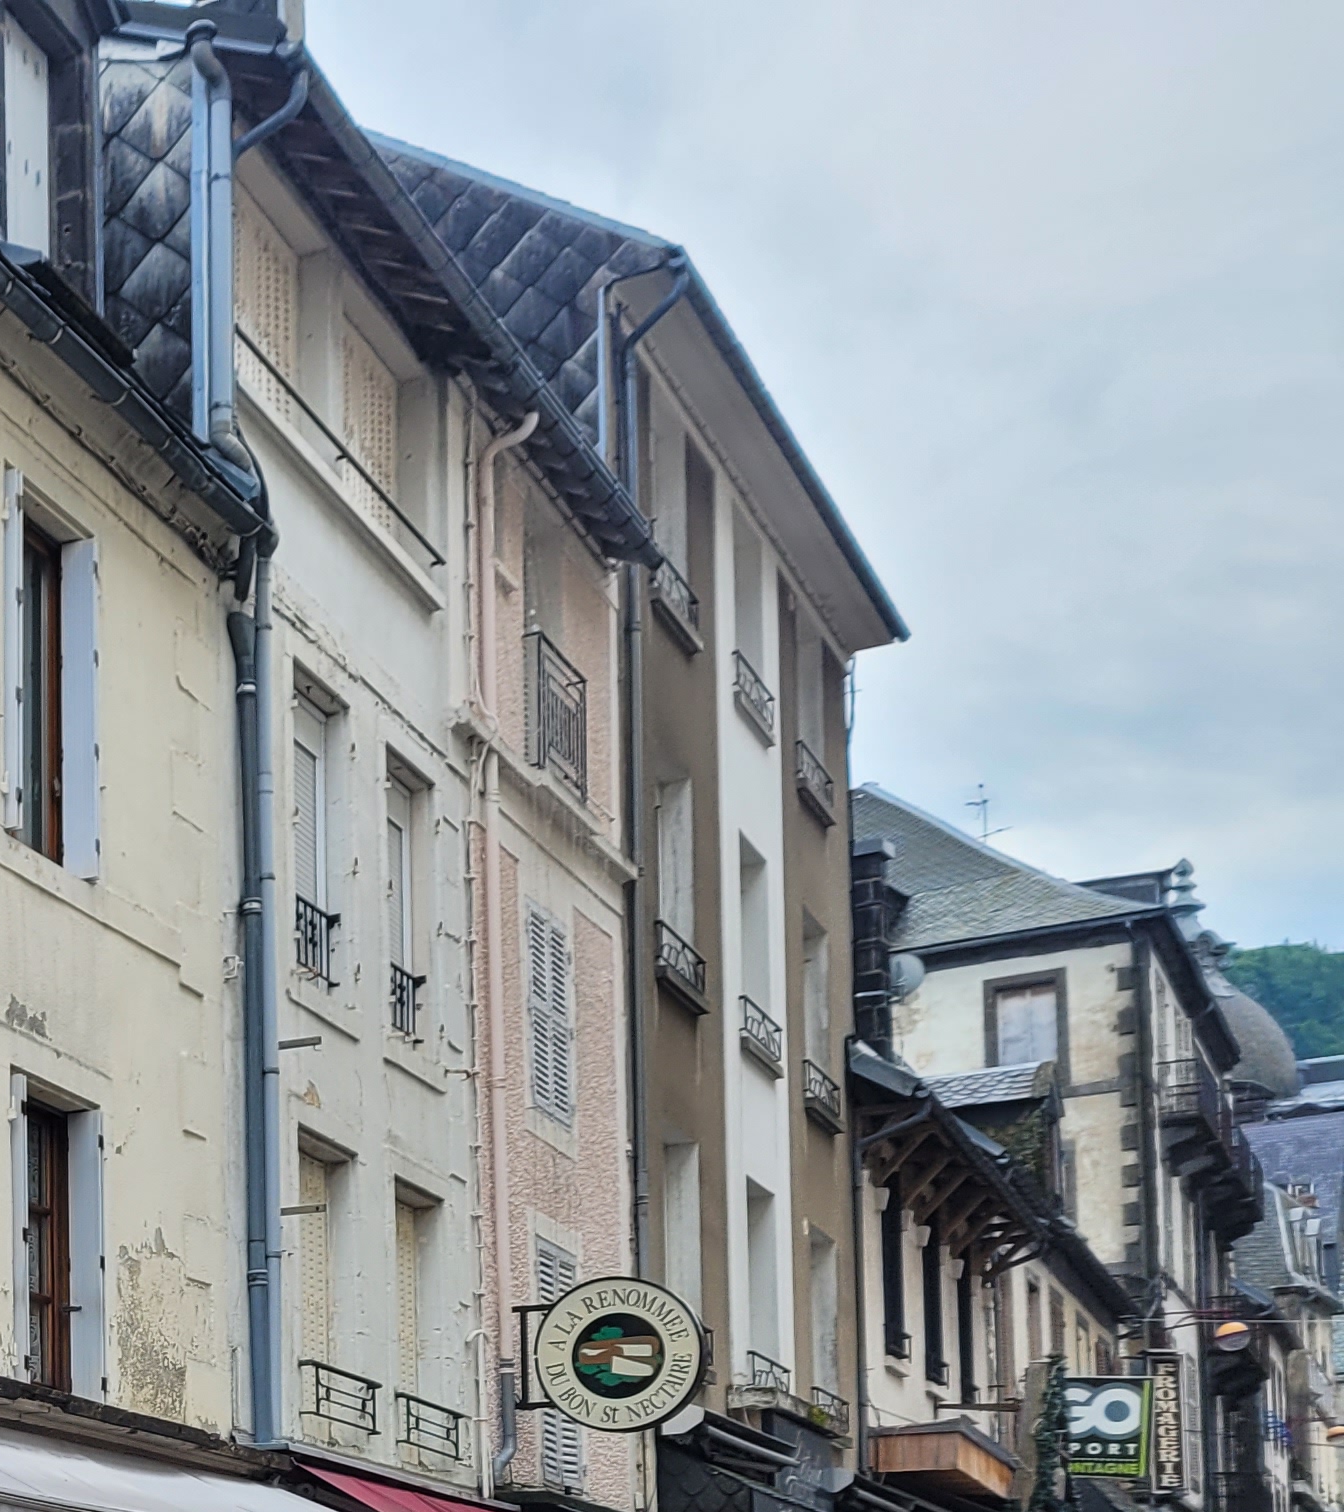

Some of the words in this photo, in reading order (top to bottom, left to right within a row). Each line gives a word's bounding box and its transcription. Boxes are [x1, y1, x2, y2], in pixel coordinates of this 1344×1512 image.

[554, 1311, 584, 1336] LA
[580, 1288, 690, 1343] RENOMMEE
[547, 1339, 567, 1352] A
[546, 1363, 570, 1387] DU
[558, 1386, 597, 1419] BON
[600, 1405, 620, 1423] St
[624, 1353, 693, 1423] NECTAIRE
[1154, 1363, 1182, 1487] FROMAGERIE
[1068, 1442, 1139, 1455] PORT
